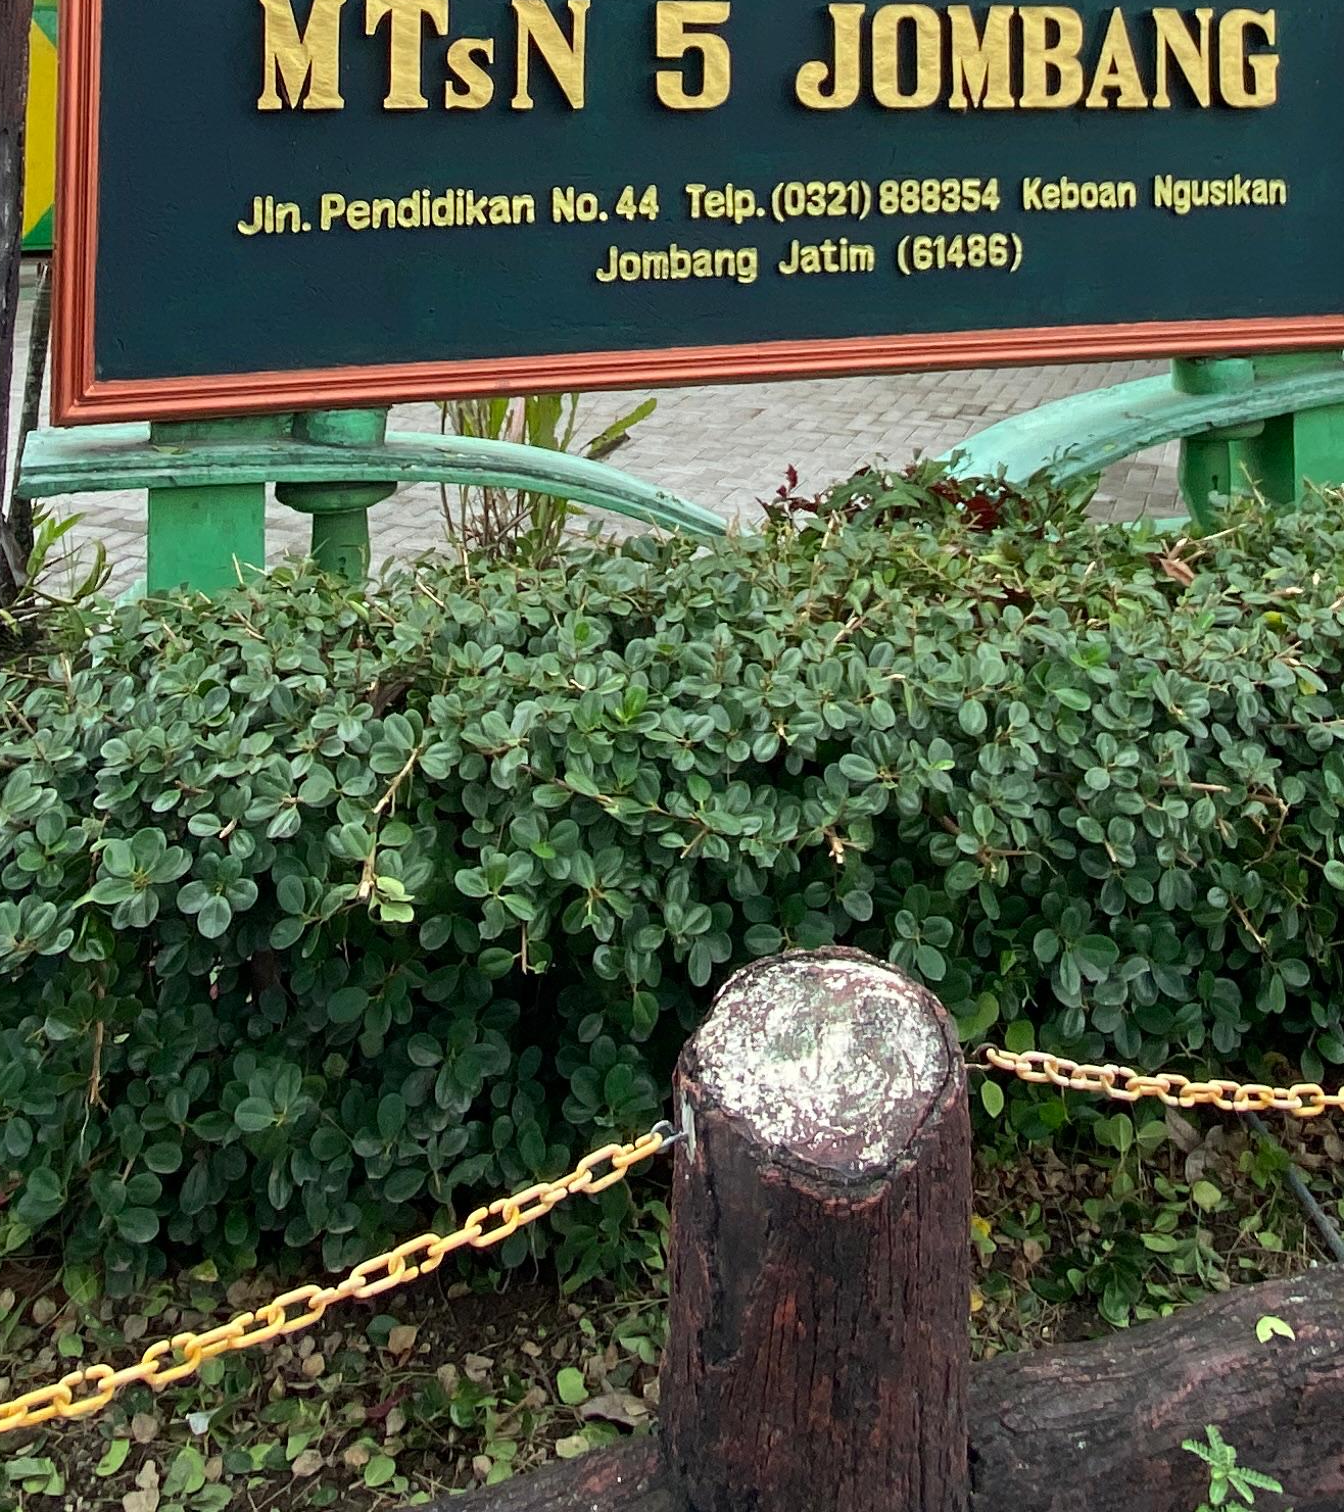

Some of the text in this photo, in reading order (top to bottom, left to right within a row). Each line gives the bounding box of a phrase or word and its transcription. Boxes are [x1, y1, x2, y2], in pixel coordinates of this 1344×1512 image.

[655, 0, 732, 110] 5
[794, 2, 1281, 111] JOMBANG
[237, 194, 311, 236] Jln.
[320, 188, 536, 231] Pendidikan
[551, 186, 609, 223] No.
[614, 185, 660, 221] 44
[878, 178, 1001, 216] 888354
[1022, 176, 1138, 211] Keboan
[595, 232, 1023, 284] Jombang Jatim (61486)
